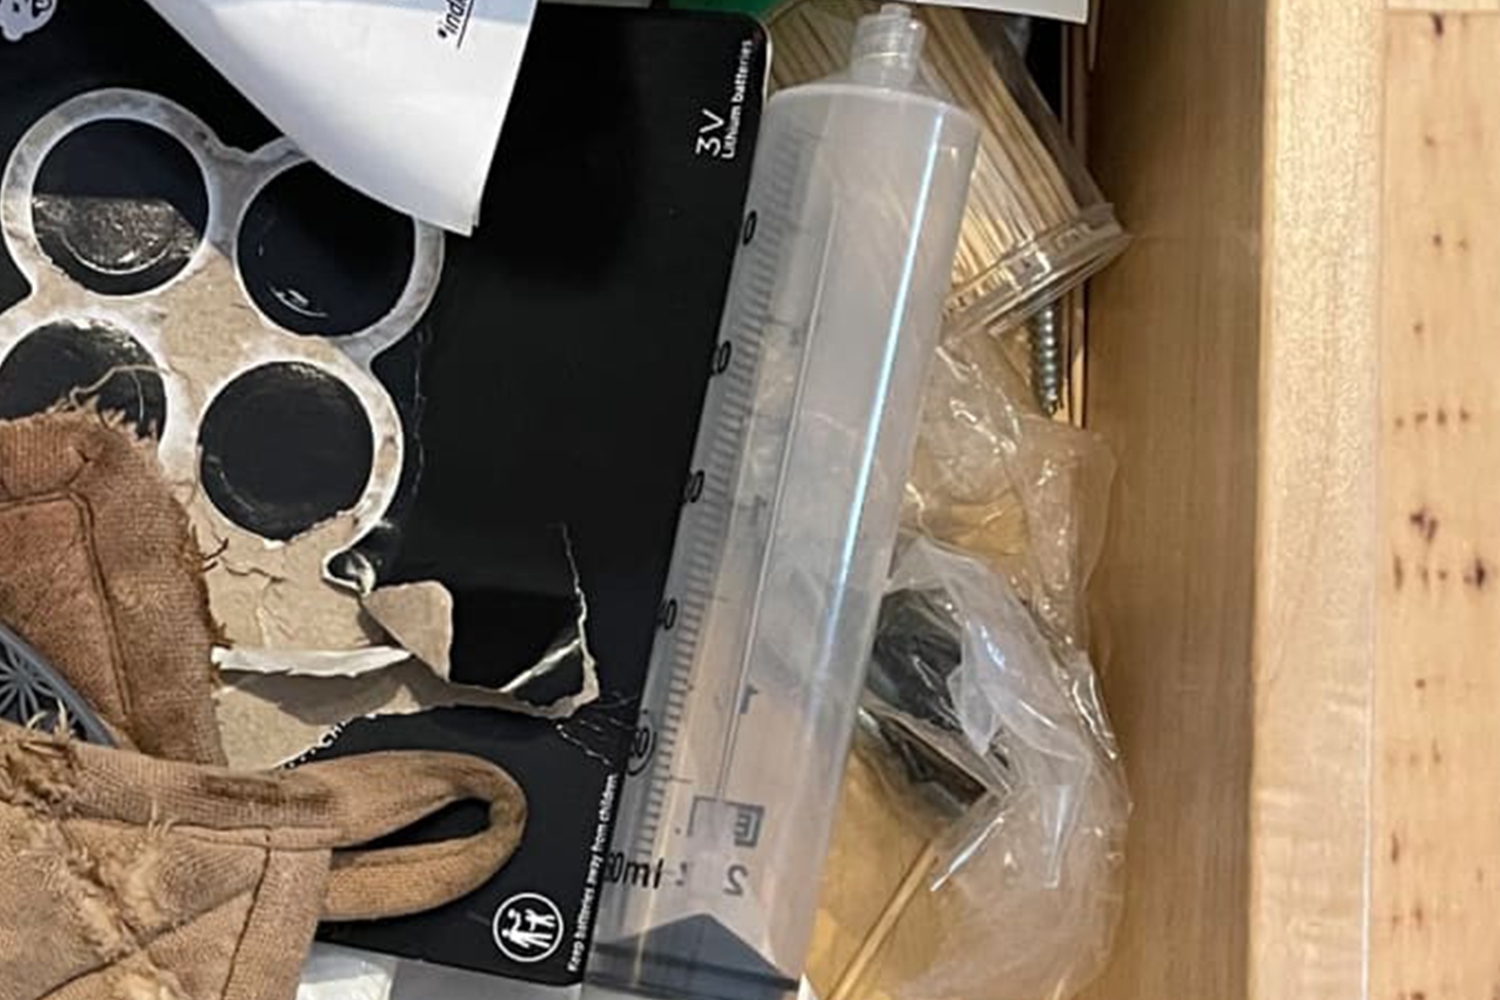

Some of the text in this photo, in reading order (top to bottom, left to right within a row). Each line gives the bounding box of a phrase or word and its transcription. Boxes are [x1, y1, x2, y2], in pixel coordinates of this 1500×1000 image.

[721, 39, 753, 159] Lithium batteries
[695, 108, 724, 156] 3V
[591, 823, 607, 852] from
[586, 854, 604, 886] away
[567, 938, 585, 972] Keep
